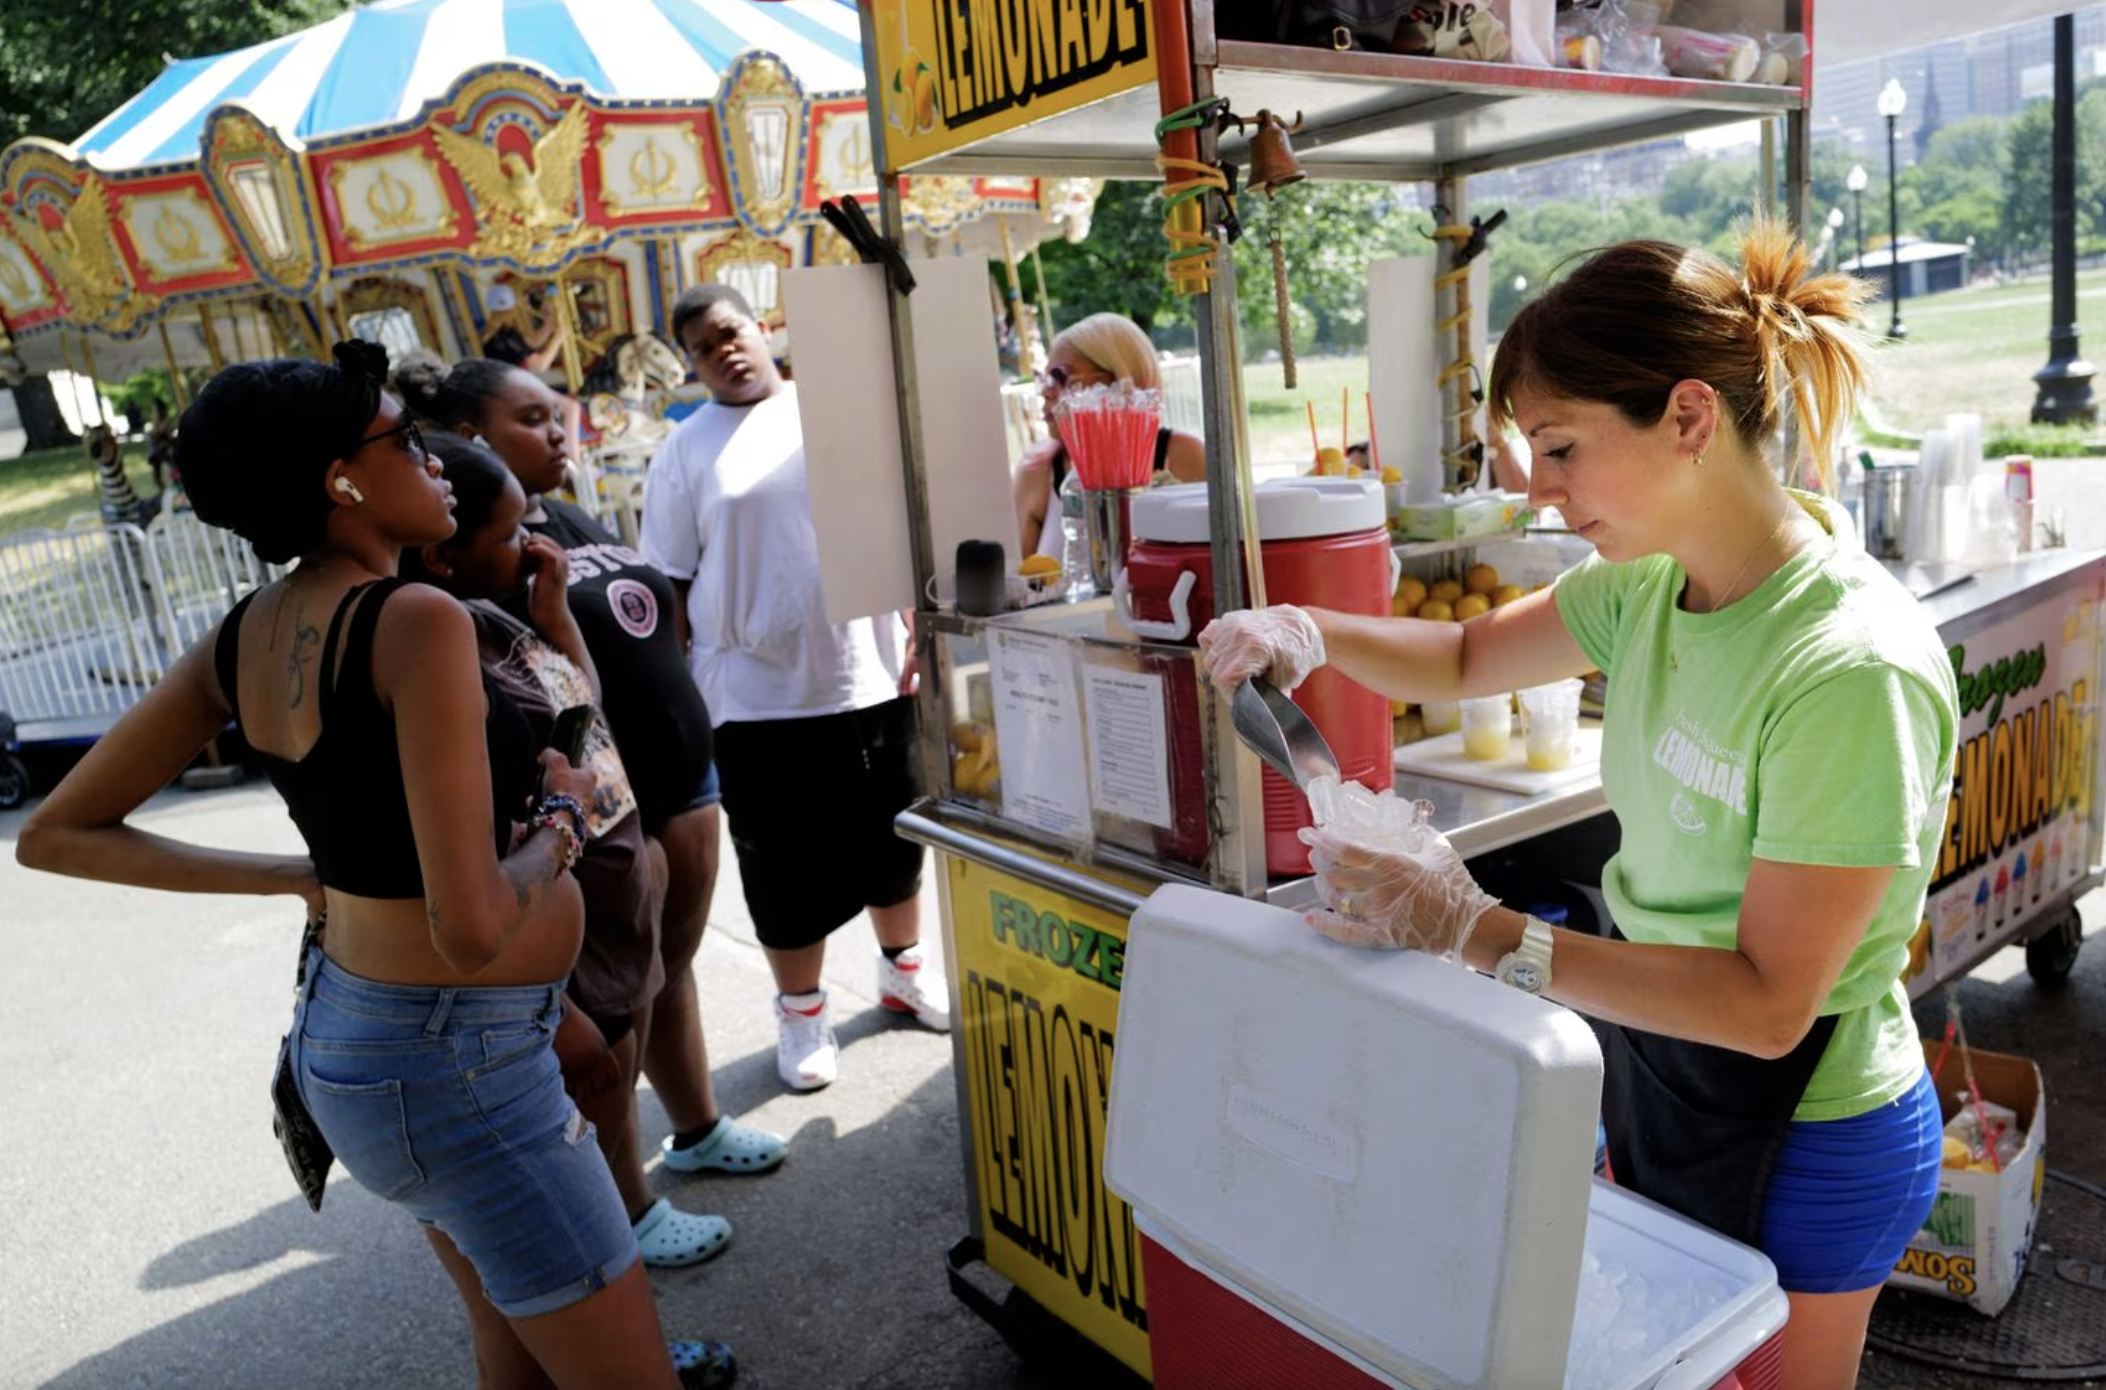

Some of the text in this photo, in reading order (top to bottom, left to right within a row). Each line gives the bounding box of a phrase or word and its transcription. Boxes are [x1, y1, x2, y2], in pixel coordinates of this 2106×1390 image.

[1653, 726, 1748, 816] LEMONA
[1928, 679, 2086, 894] EMONADE
[989, 890, 1127, 992] FROZE
[968, 969, 1148, 1333] LEMON
